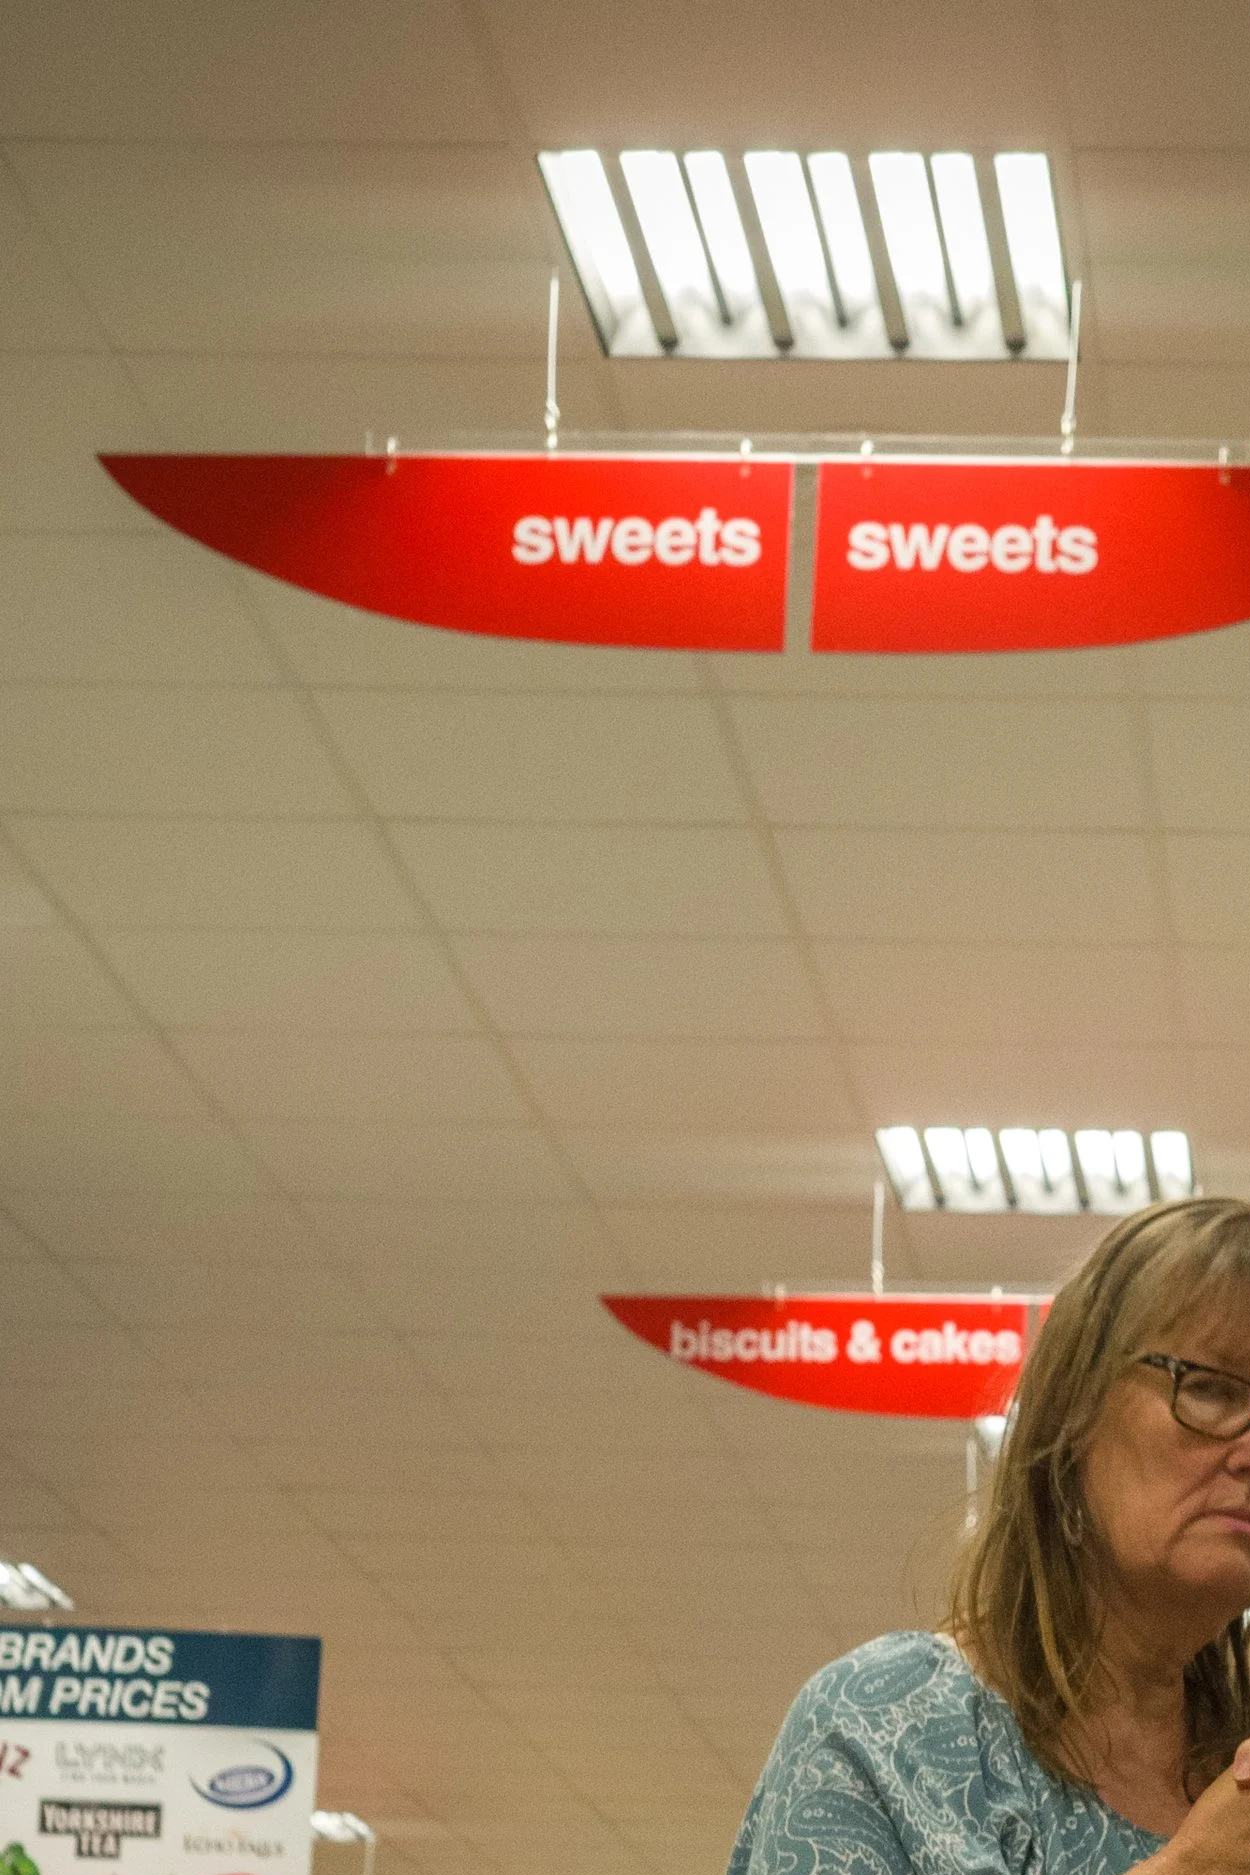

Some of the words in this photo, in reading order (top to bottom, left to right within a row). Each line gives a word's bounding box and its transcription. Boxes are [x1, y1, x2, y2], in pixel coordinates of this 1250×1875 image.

[511, 507, 762, 567] sweets
[846, 514, 1100, 574] sweets
[670, 1319, 838, 1362] biscuits
[846, 1319, 881, 1364] &
[890, 1321, 1022, 1364] cakes
[0, 1631, 175, 1676] BRANDS
[0, 1675, 43, 1714] M
[50, 1676, 211, 1720] PRICES
[80, 1832, 117, 1858] TEA
